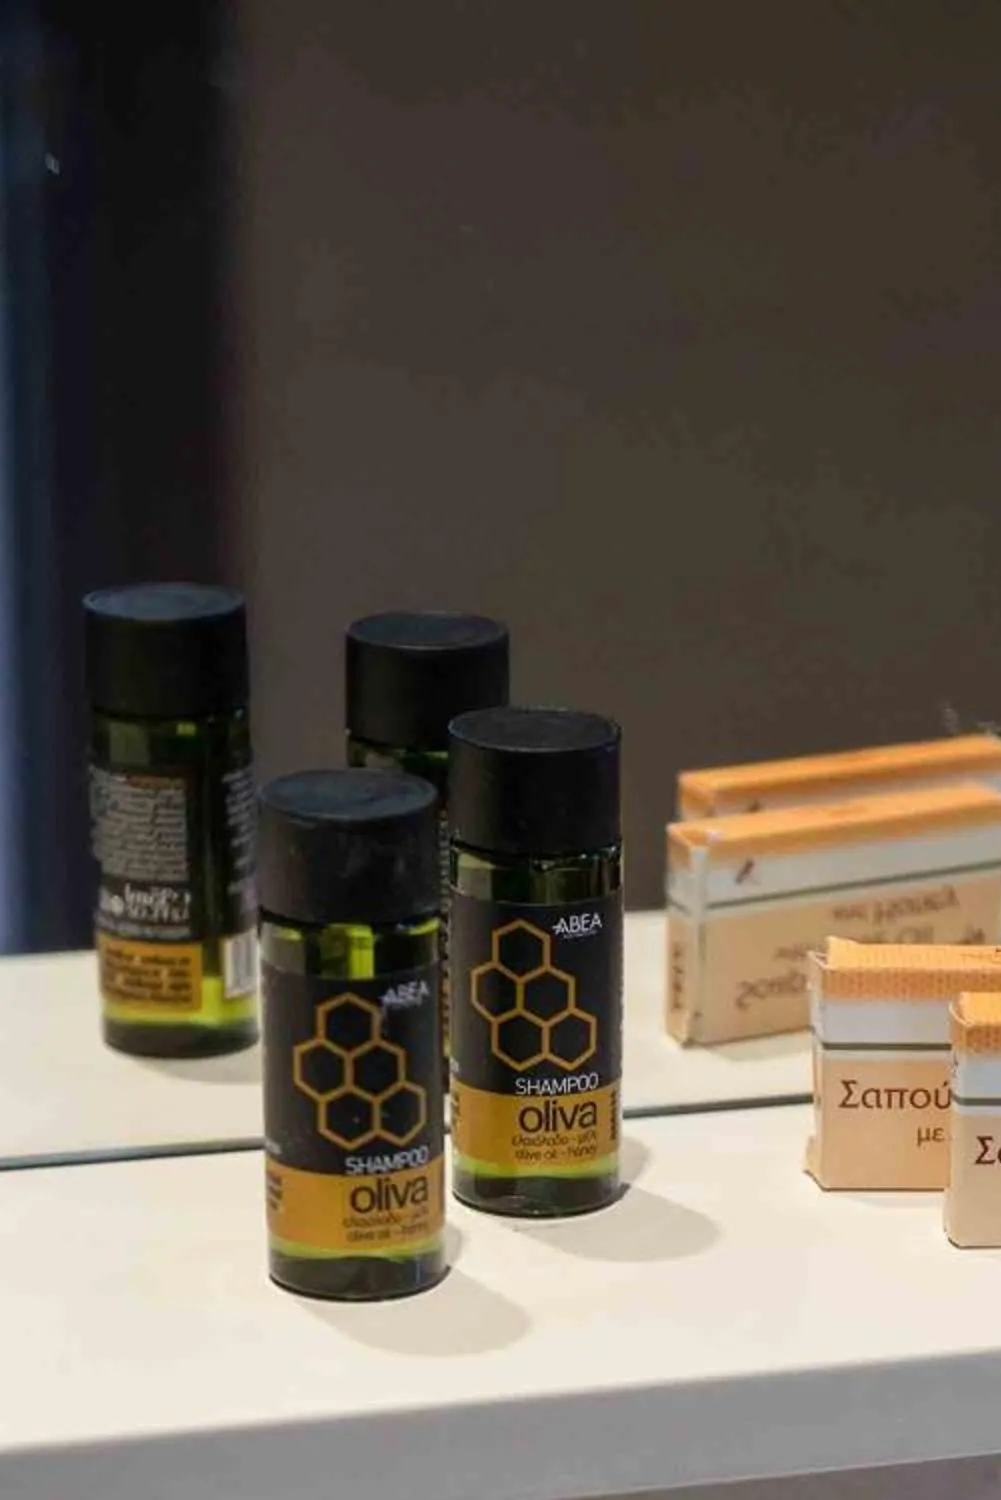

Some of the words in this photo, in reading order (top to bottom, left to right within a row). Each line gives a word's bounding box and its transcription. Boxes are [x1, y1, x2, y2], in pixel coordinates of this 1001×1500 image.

[515, 1072, 599, 1097] SHAMPOO
[838, 1078, 951, 1111] Σαπού
[518, 1100, 598, 1135] oliva
[916, 1125, 945, 1148] με
[345, 1146, 429, 1176] SHAMPOO
[350, 1175, 429, 1215] oliva
